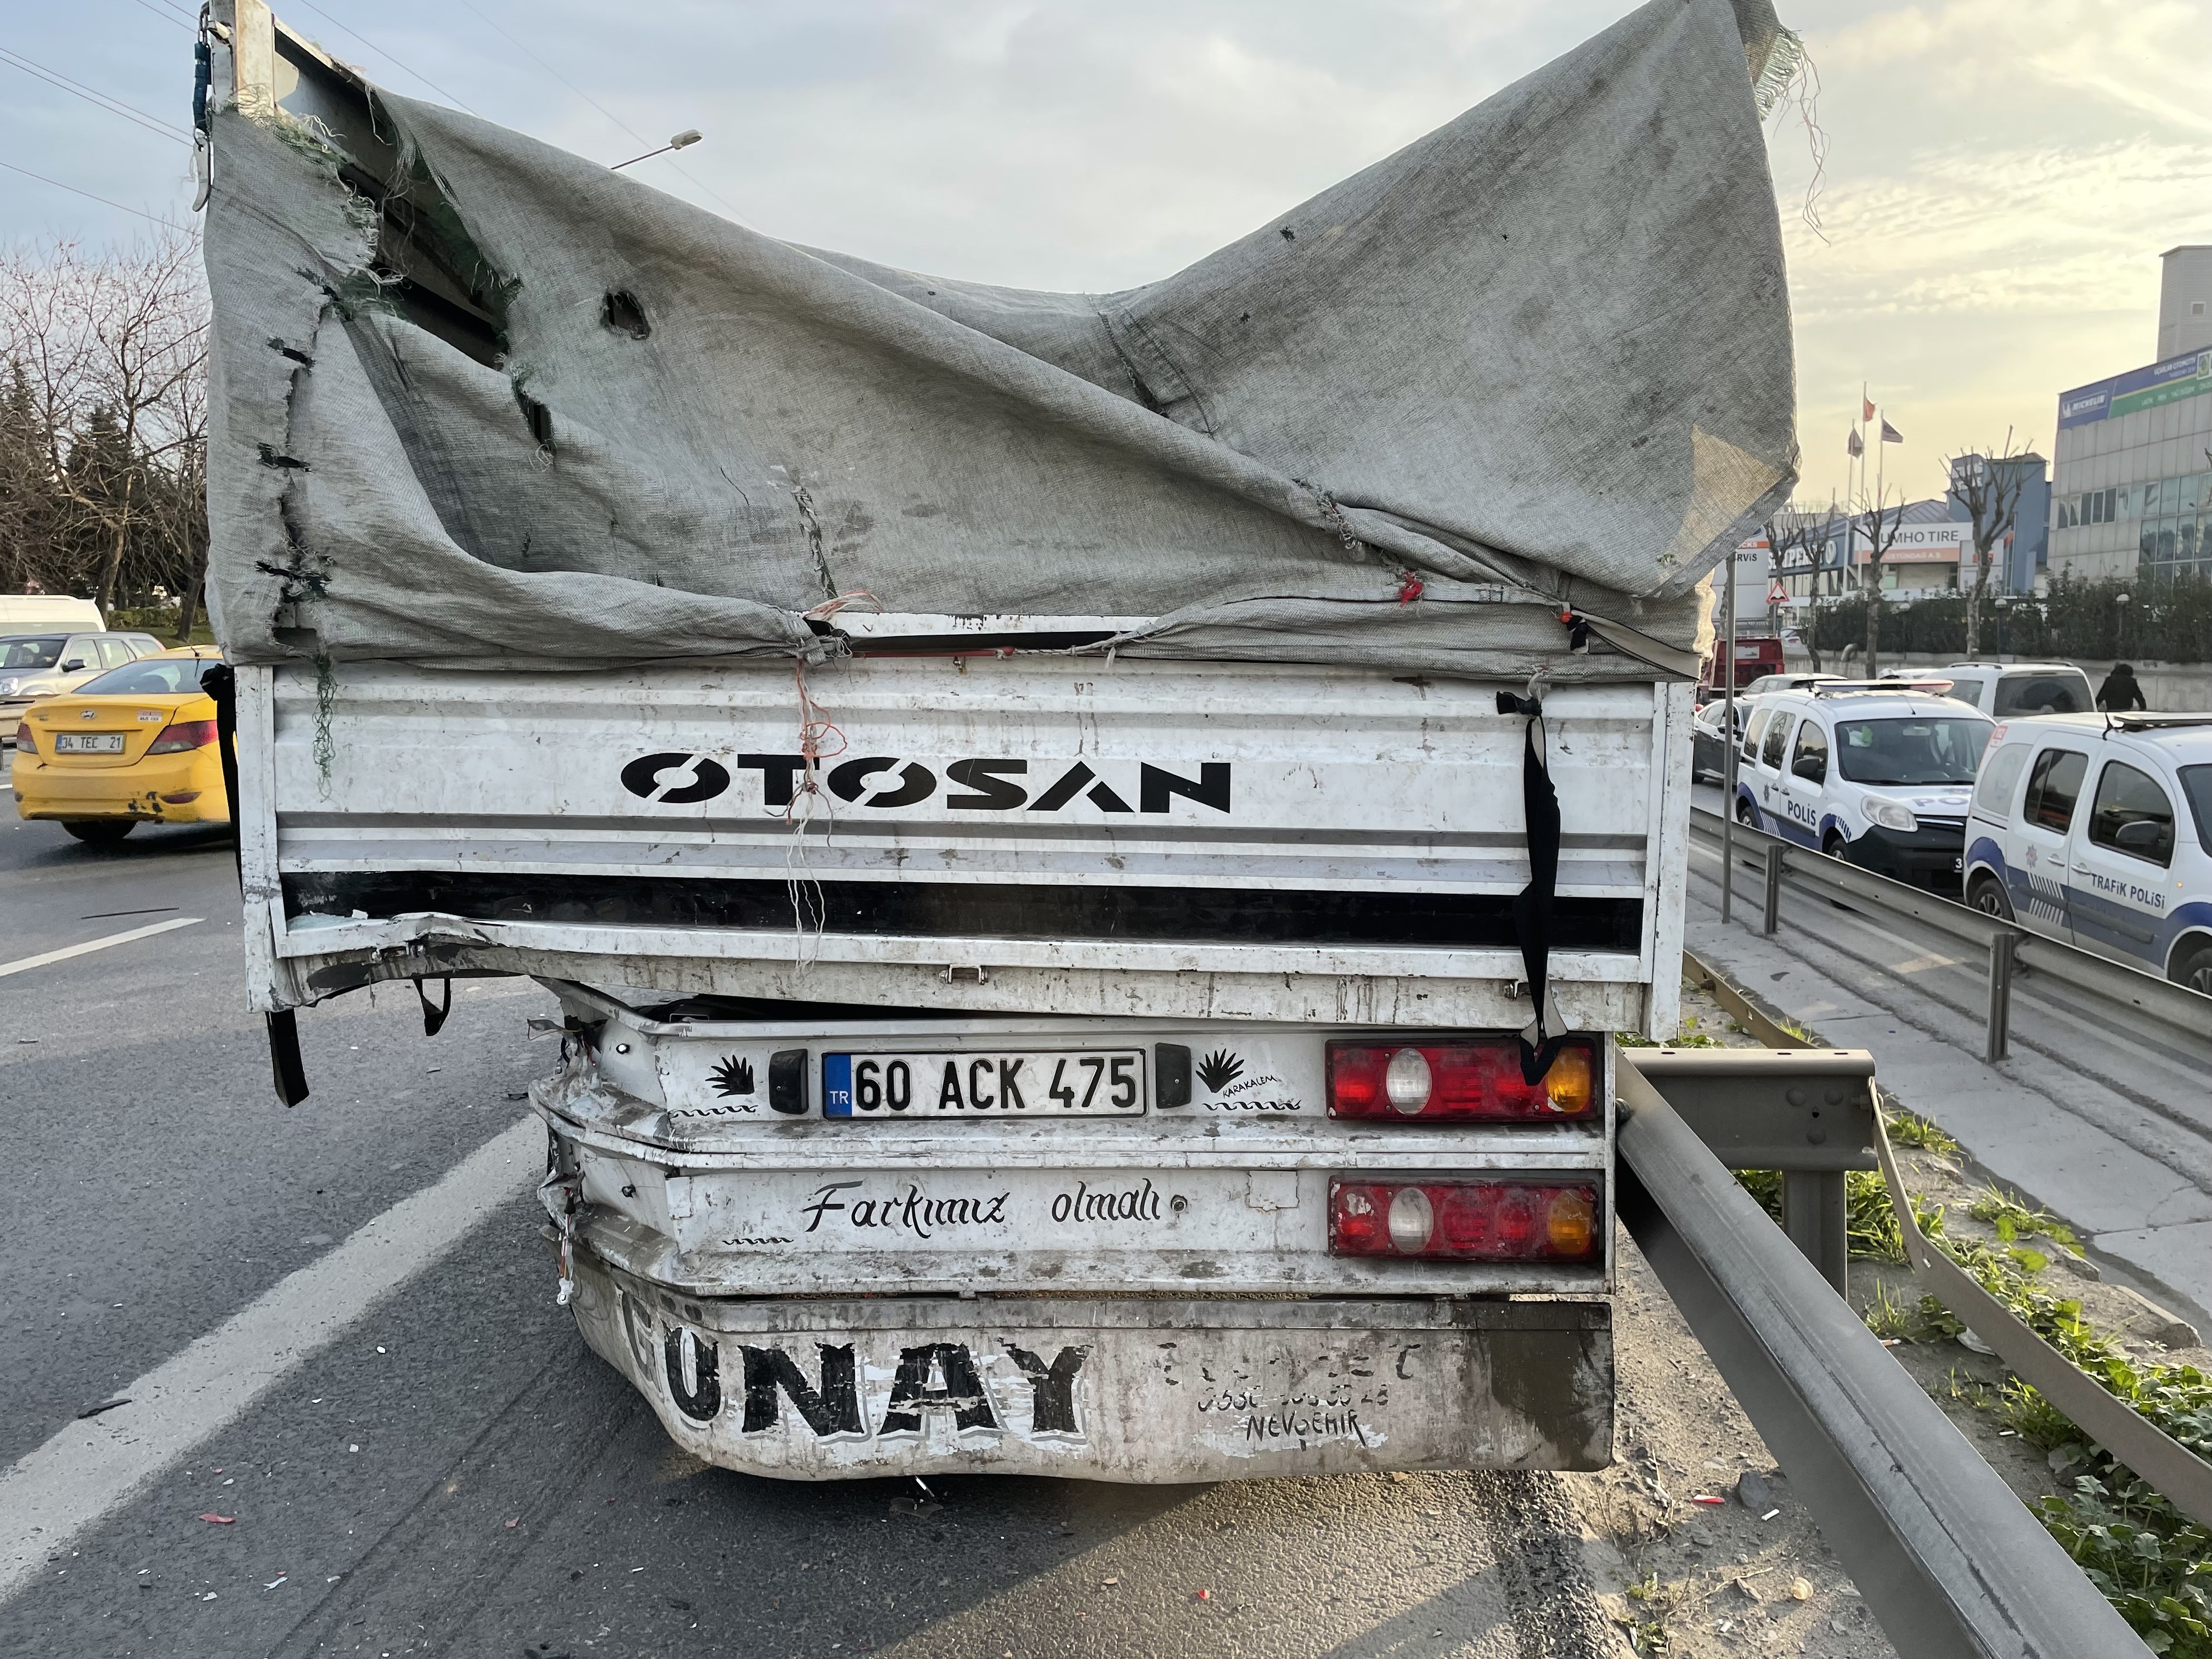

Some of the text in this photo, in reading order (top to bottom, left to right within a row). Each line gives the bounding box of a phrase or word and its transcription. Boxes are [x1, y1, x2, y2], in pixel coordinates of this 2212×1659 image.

[1880, 530, 1959, 544] UMHO TIRE
[62, 736, 121, 749] 34 TEC 21
[620, 752, 1231, 814] OTOSAN
[1787, 799, 1816, 827] POLİS
[855, 1058, 1136, 1111] 60 ACK 475
[1223, 1074, 1278, 1099] KARAKALEM
[830, 1091, 849, 1105] TR
[803, 1177, 1161, 1239] Farkımız olmalı
